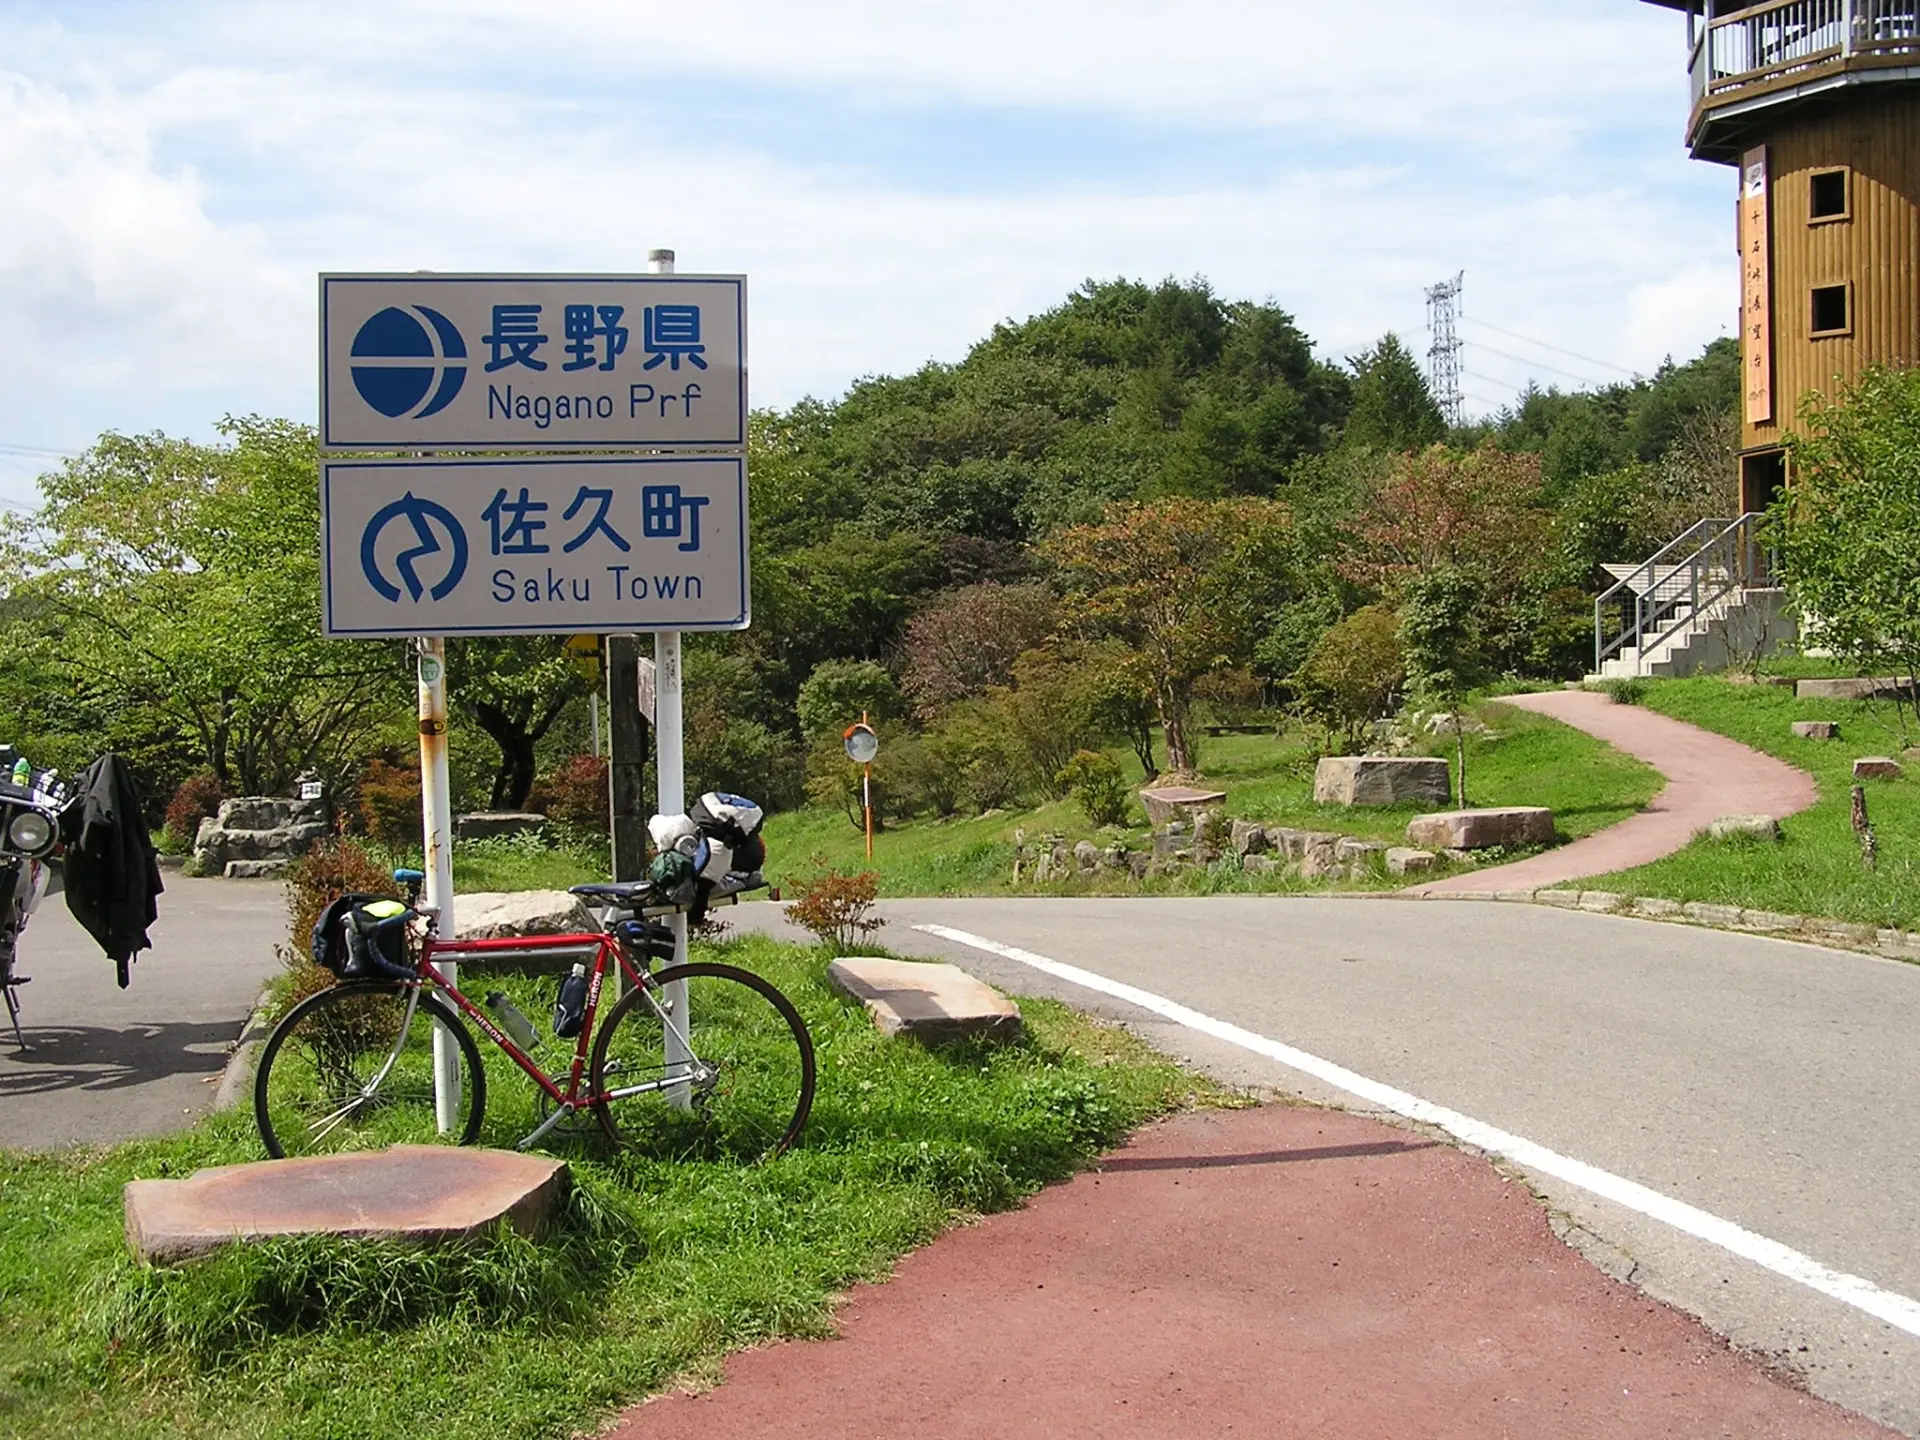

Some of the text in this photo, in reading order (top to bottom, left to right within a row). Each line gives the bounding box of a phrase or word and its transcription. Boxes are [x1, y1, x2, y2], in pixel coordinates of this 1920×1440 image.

[481, 304, 707, 372] 長野県
[488, 383, 701, 429] Nagano Prf
[480, 485, 710, 556] 佐久町
[491, 566, 702, 604] Saku Town
[589, 971, 603, 1007] HERON
[475, 1014, 504, 1042] HERON
